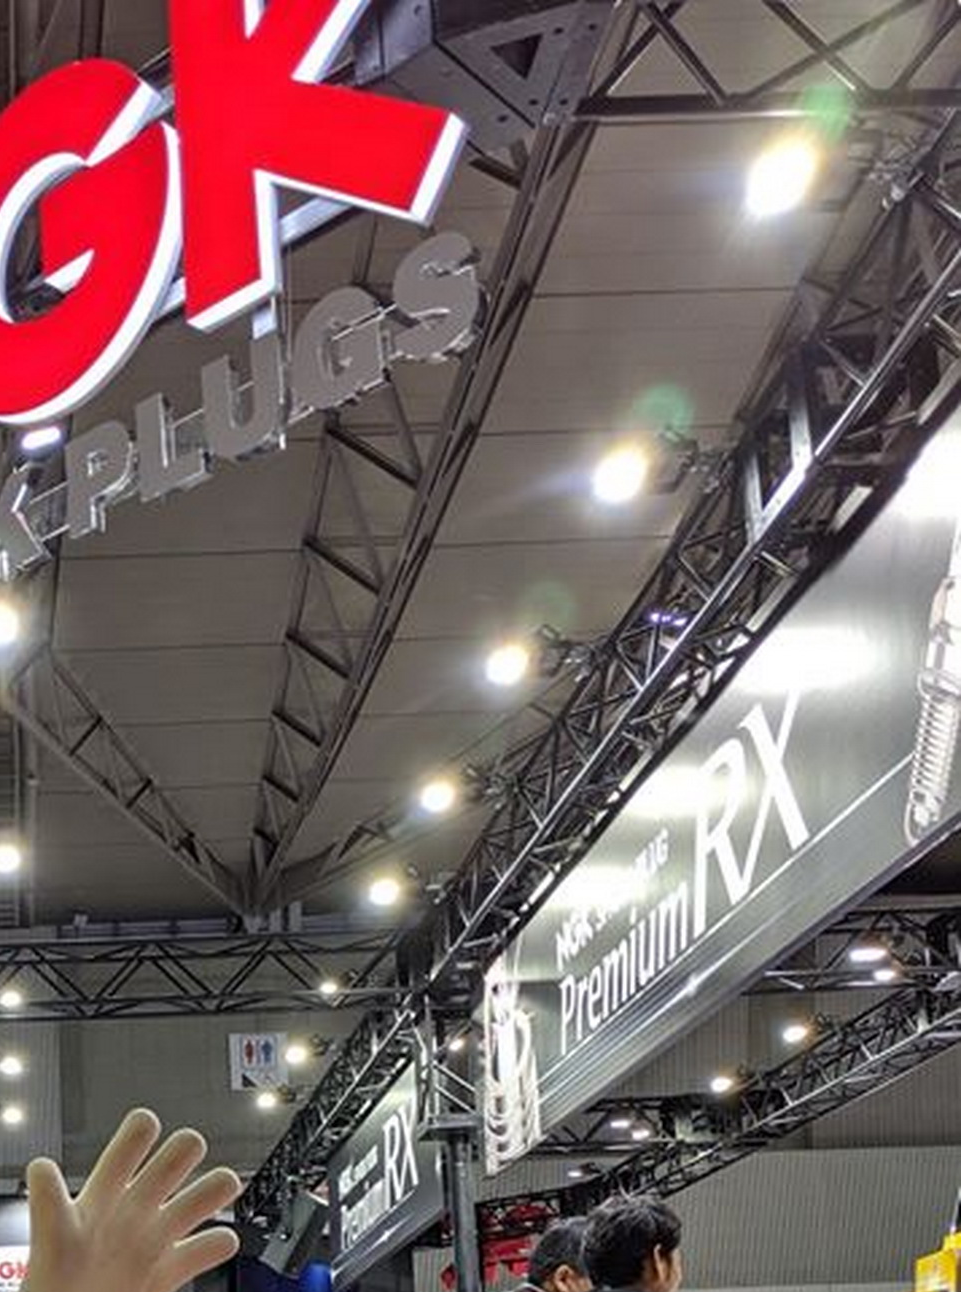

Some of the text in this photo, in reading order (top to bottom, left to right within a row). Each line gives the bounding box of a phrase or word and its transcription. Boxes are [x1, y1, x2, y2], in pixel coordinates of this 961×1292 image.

[63, 232, 486, 537] PLUGS
[558, 688, 809, 1056] Premium RX
